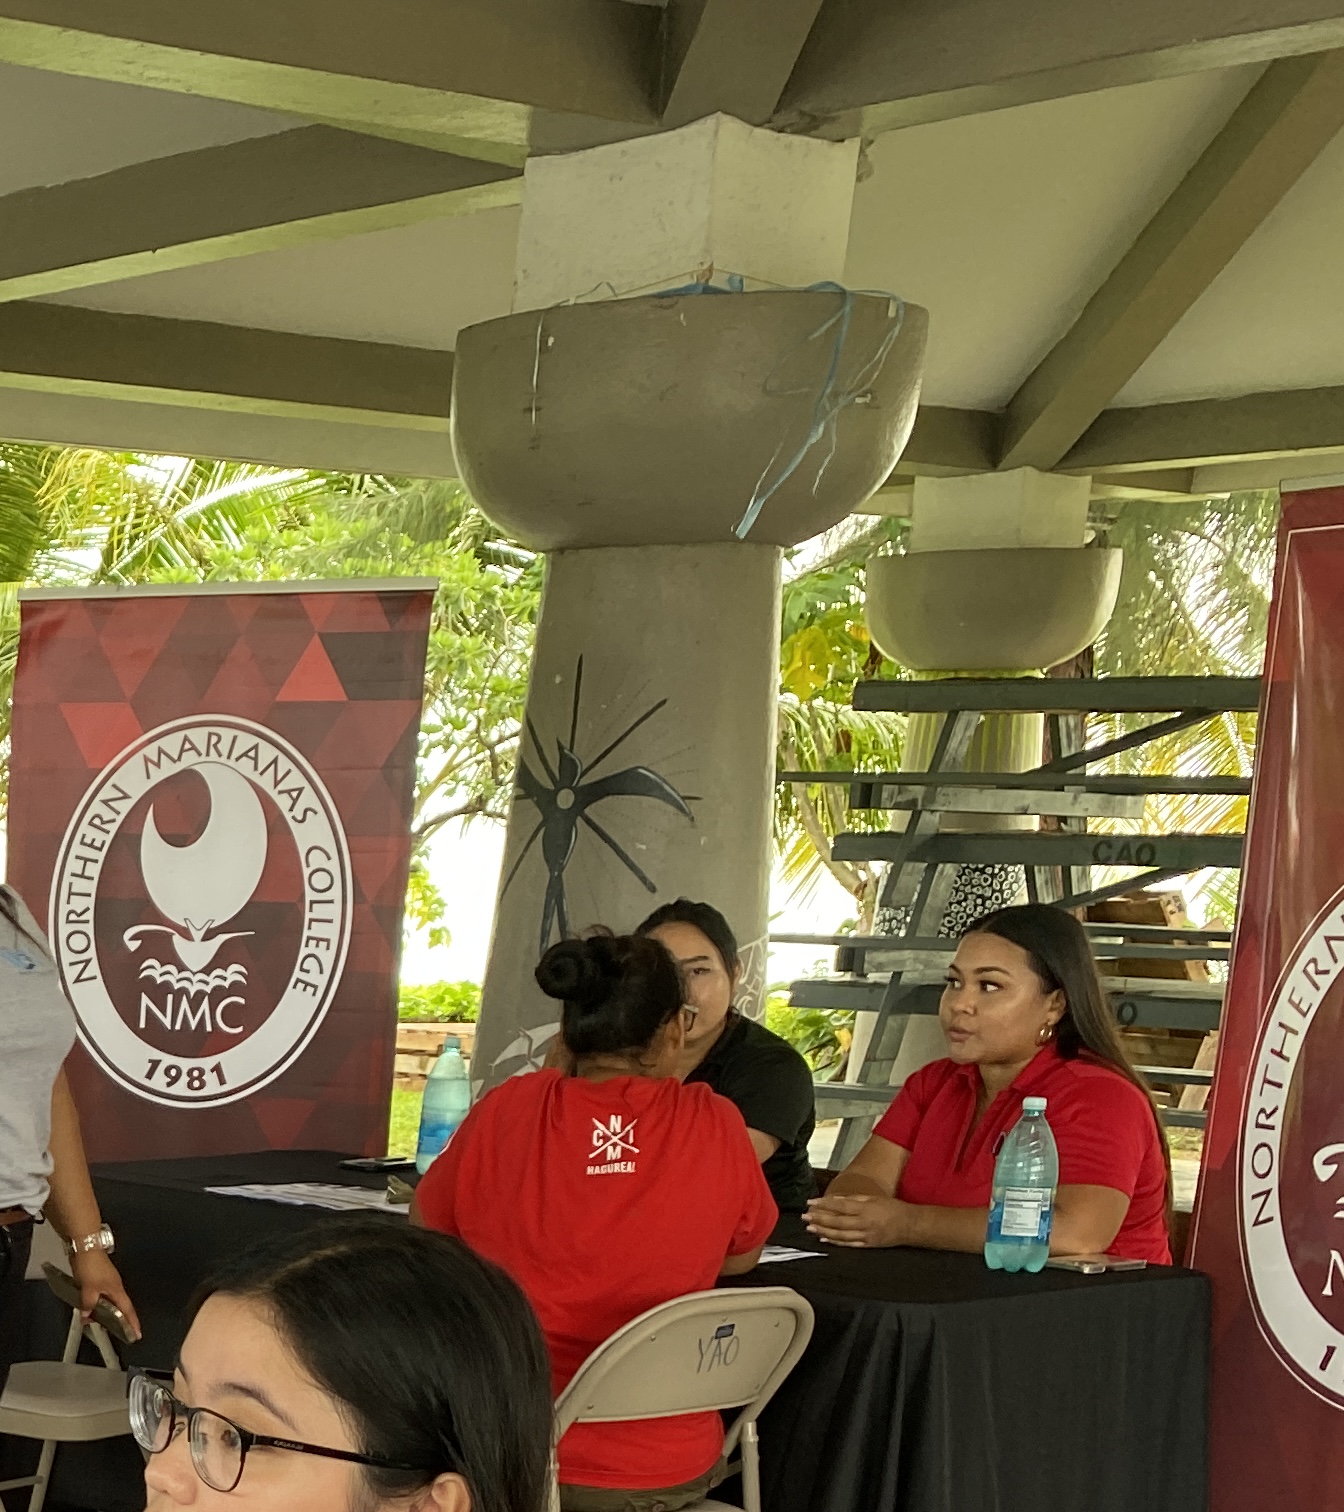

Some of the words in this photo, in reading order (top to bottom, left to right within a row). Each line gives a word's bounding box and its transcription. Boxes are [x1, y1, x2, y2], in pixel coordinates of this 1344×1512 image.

[143, 731, 318, 826] MARIANAS
[65, 783, 134, 984] NORTHERN
[292, 844, 334, 998] COLLEGE
[138, 993, 246, 1035] NMC
[145, 1058, 229, 1092] 1981
